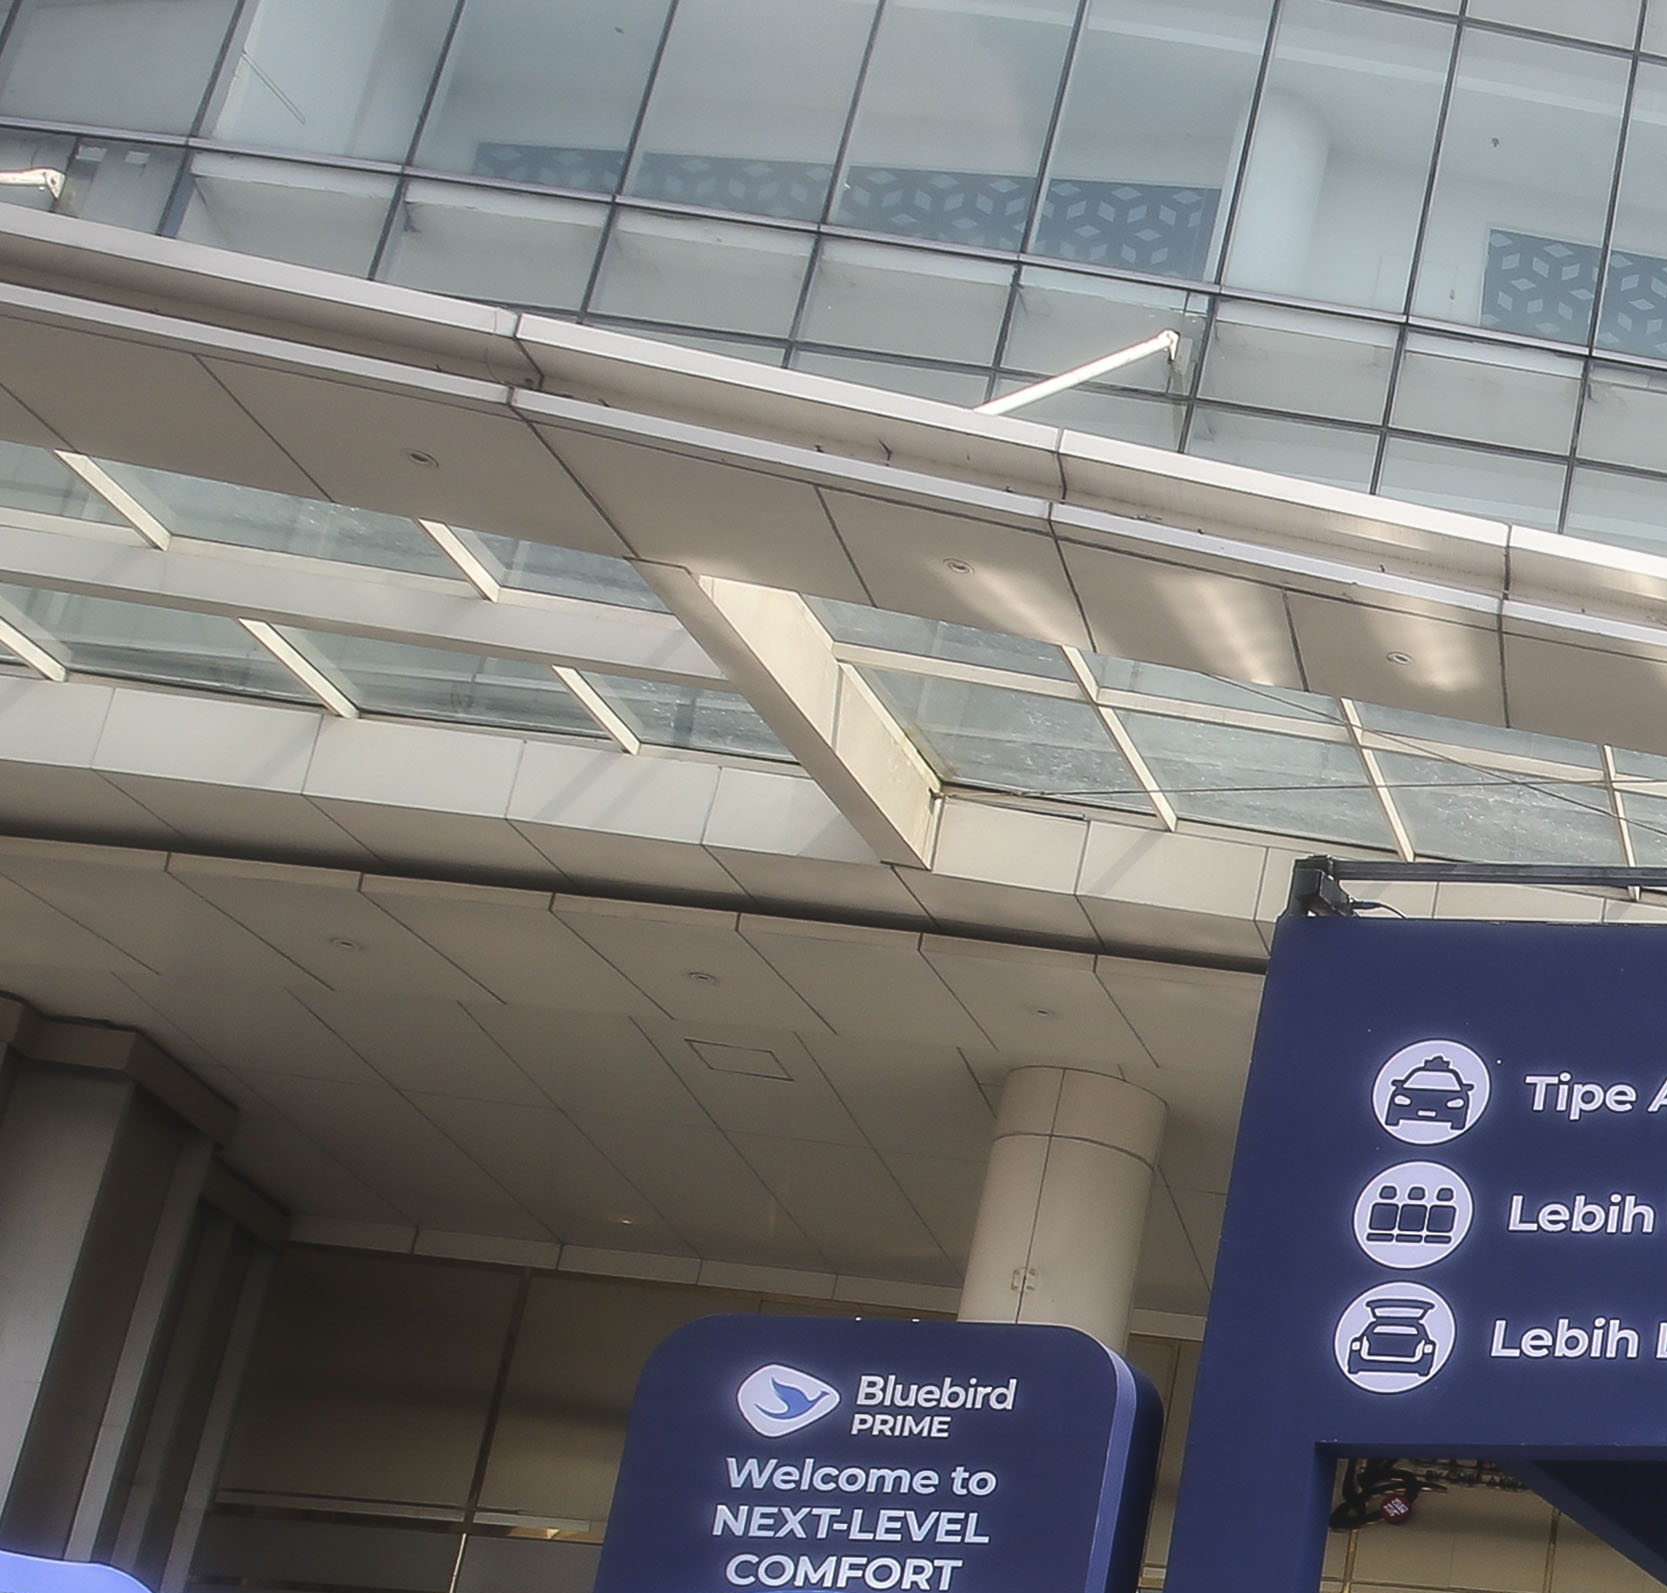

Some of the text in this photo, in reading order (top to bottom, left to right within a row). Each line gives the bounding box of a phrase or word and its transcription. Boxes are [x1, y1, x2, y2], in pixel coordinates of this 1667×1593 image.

[1525, 1073, 1636, 1120] Tipe
[1507, 1193, 1654, 1234] Lebih
[1490, 1318, 1639, 1360] Lebih
[855, 1375, 1017, 1411] Bluebird
[851, 1414, 951, 1437] PRIME
[726, 1457, 997, 1496] Welcome to
[712, 1505, 990, 1543] NEXT-LEVEL
[725, 1554, 962, 1591] COMFORT
